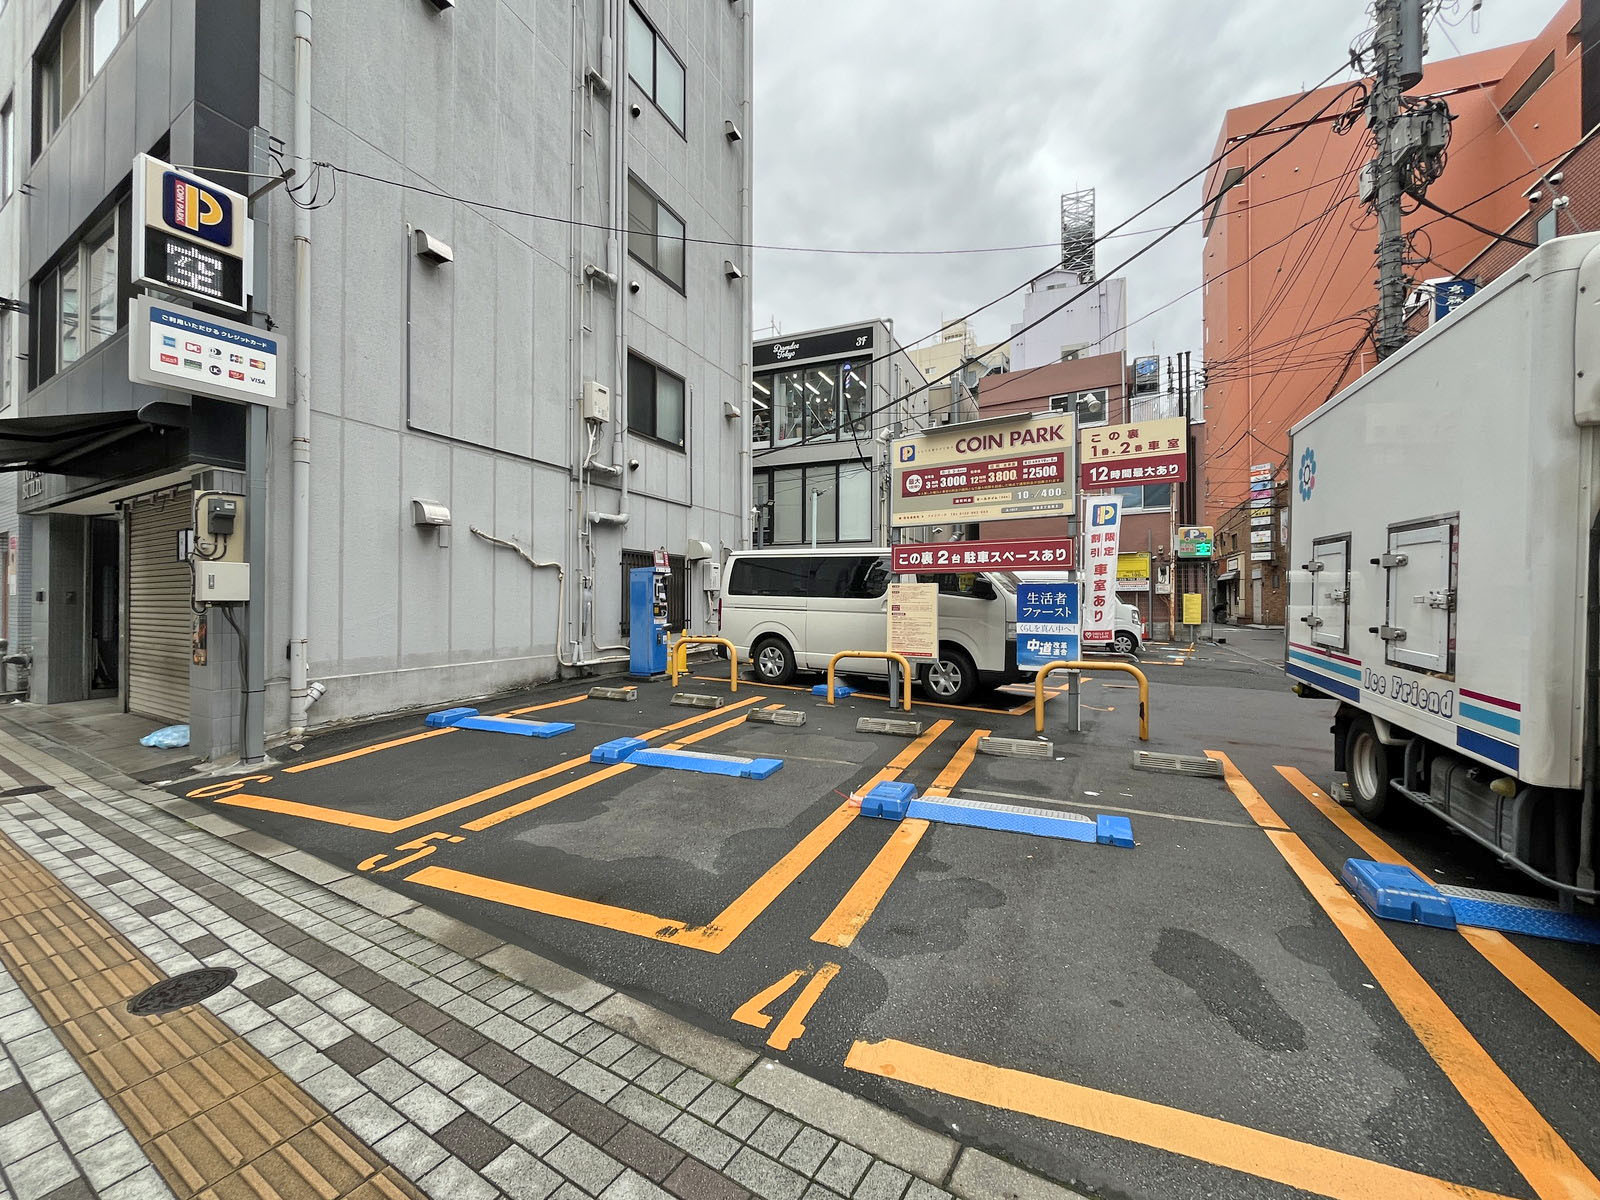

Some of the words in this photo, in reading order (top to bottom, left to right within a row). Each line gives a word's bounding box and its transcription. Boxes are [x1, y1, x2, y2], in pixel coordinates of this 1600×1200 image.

[176, 184, 185, 204] COIN
[176, 204, 185, 223] PARK
[185, 184, 224, 232] P
[166, 243, 222, 297] 空
[161, 315, 220, 335] ご利用いただける
[220, 331, 268, 348] クレジットカード
[855, 336, 868, 347] 3F
[250, 376, 266, 385] VISA
[955, 433, 1004, 454] COIN
[1009, 424, 1064, 447] PARK
[1091, 428, 1139, 443] この裏
[1089, 464, 1179, 482] 12時間最大あり
[1090, 533, 1101, 558] 割引
[1103, 532, 1115, 557] 限定
[1026, 592, 1067, 605] 生活者
[1093, 563, 1108, 623] 車室あり
[1022, 607, 1072, 618] ファースト
[1027, 639, 1052, 655] 中道
[1364, 667, 1386, 694] Ice
[1391, 675, 1454, 718] Friend
[185, 774, 274, 798] 6
[356, 832, 466, 874] 5
[731, 961, 842, 1051] 4
